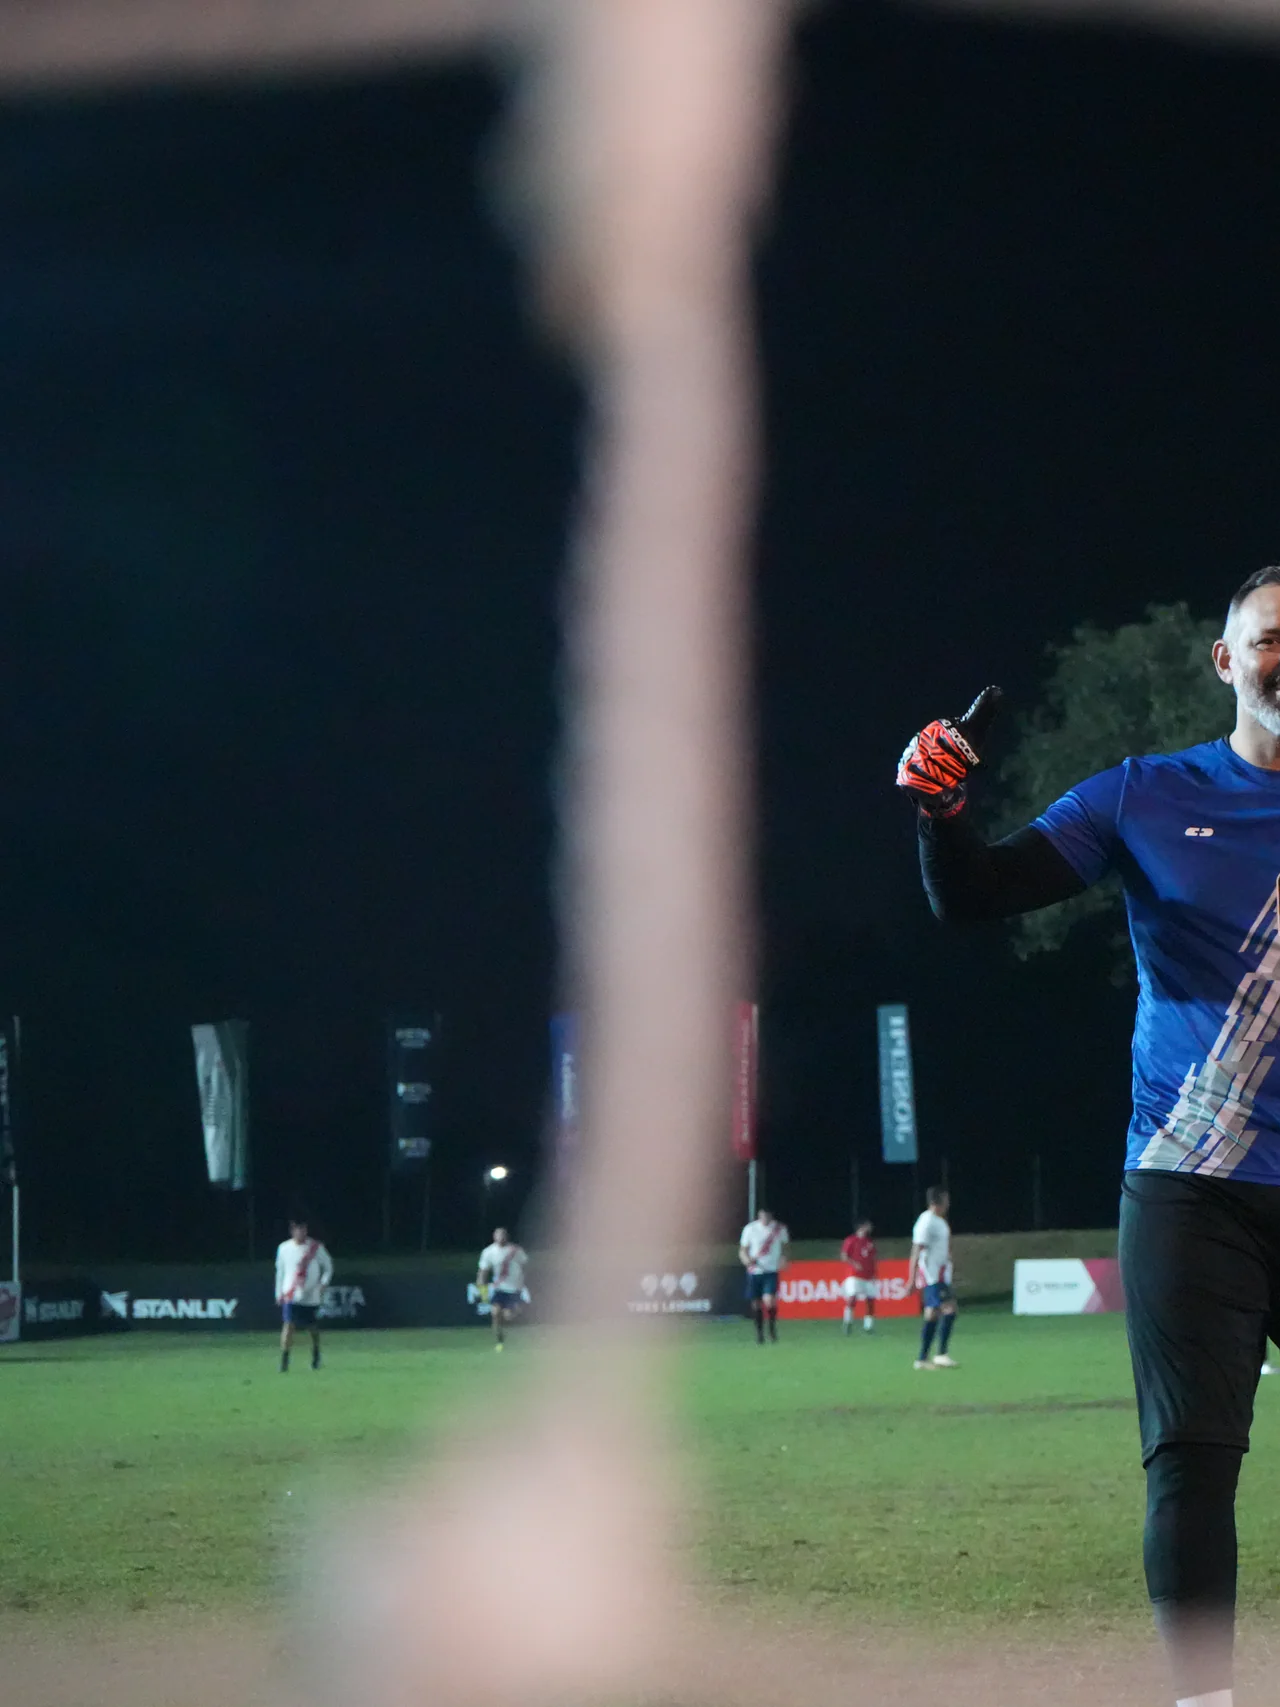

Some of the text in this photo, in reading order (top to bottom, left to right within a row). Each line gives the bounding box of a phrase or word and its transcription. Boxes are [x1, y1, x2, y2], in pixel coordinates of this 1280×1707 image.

[948, 727, 980, 766] SOCCER
[324, 1285, 366, 1305] ETA
[779, 1278, 907, 1303] UDAMIS
[133, 1299, 239, 1319] STANLEY
